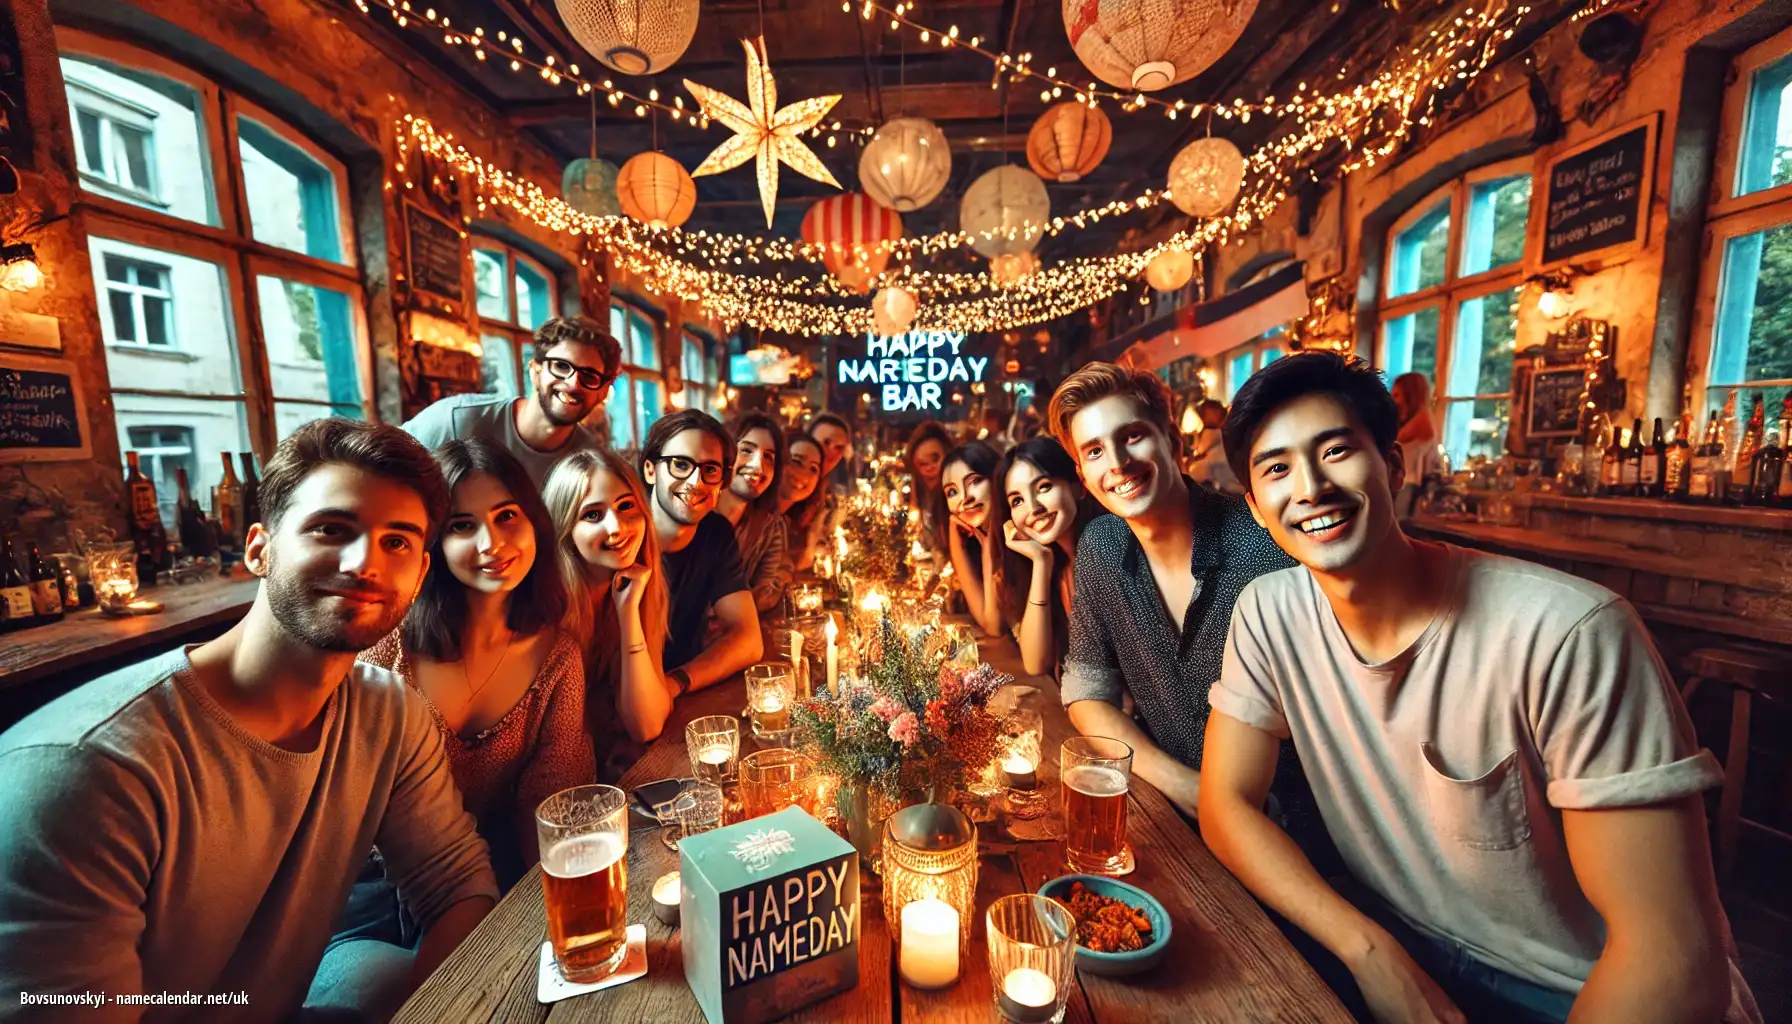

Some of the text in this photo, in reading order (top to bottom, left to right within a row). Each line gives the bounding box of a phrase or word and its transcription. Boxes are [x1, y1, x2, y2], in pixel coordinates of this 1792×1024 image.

[867, 331, 965, 357] HAPPY
[881, 382, 942, 412] BAR
[732, 860, 849, 940] HAPPY
[728, 903, 856, 987] NAMEDAY
